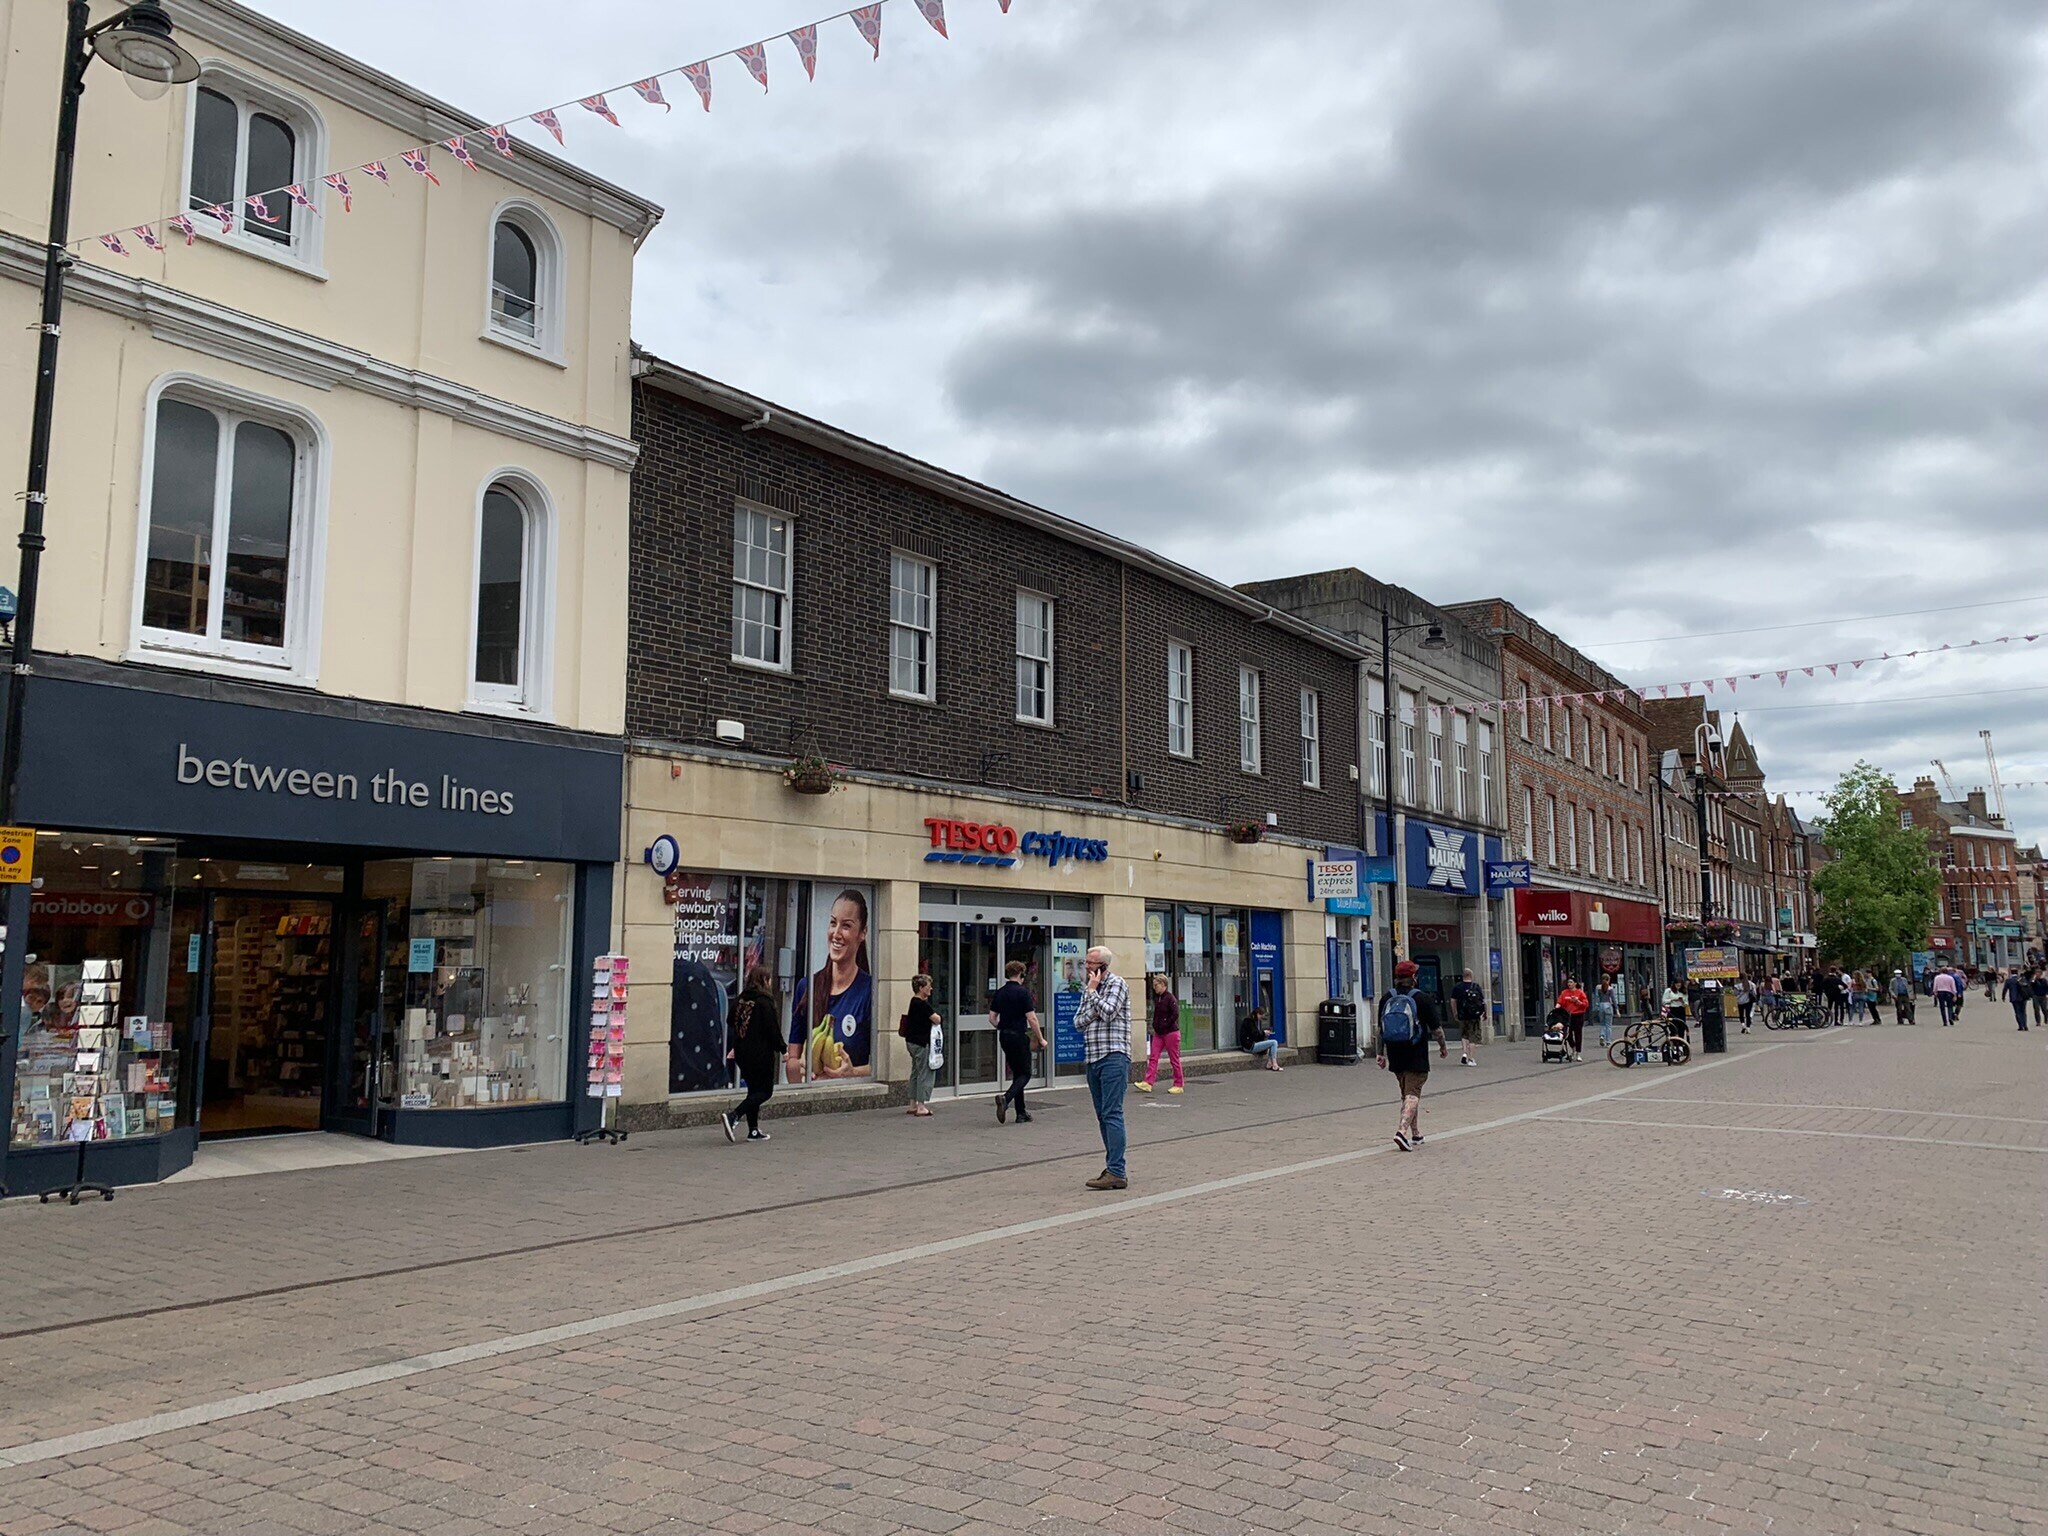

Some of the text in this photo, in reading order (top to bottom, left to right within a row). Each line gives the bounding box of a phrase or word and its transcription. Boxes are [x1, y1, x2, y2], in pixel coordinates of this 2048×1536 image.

[177, 743, 514, 815] between the lines
[924, 817, 1108, 867] TESCO express
[1428, 846, 1466, 871] HALIFAX
[1317, 864, 1353, 873] TESCO
[1491, 871, 1528, 879] HALIFAX
[1317, 877, 1354, 887] express
[678, 886, 711, 902] erving
[1537, 909, 1568, 921] wilko
[678, 932, 738, 945] little better
[1057, 942, 1079, 954] Hello.
[1251, 942, 1260, 950] Cash
[701, 947, 720, 962] day
[1637, 1053, 1643, 1061] P
